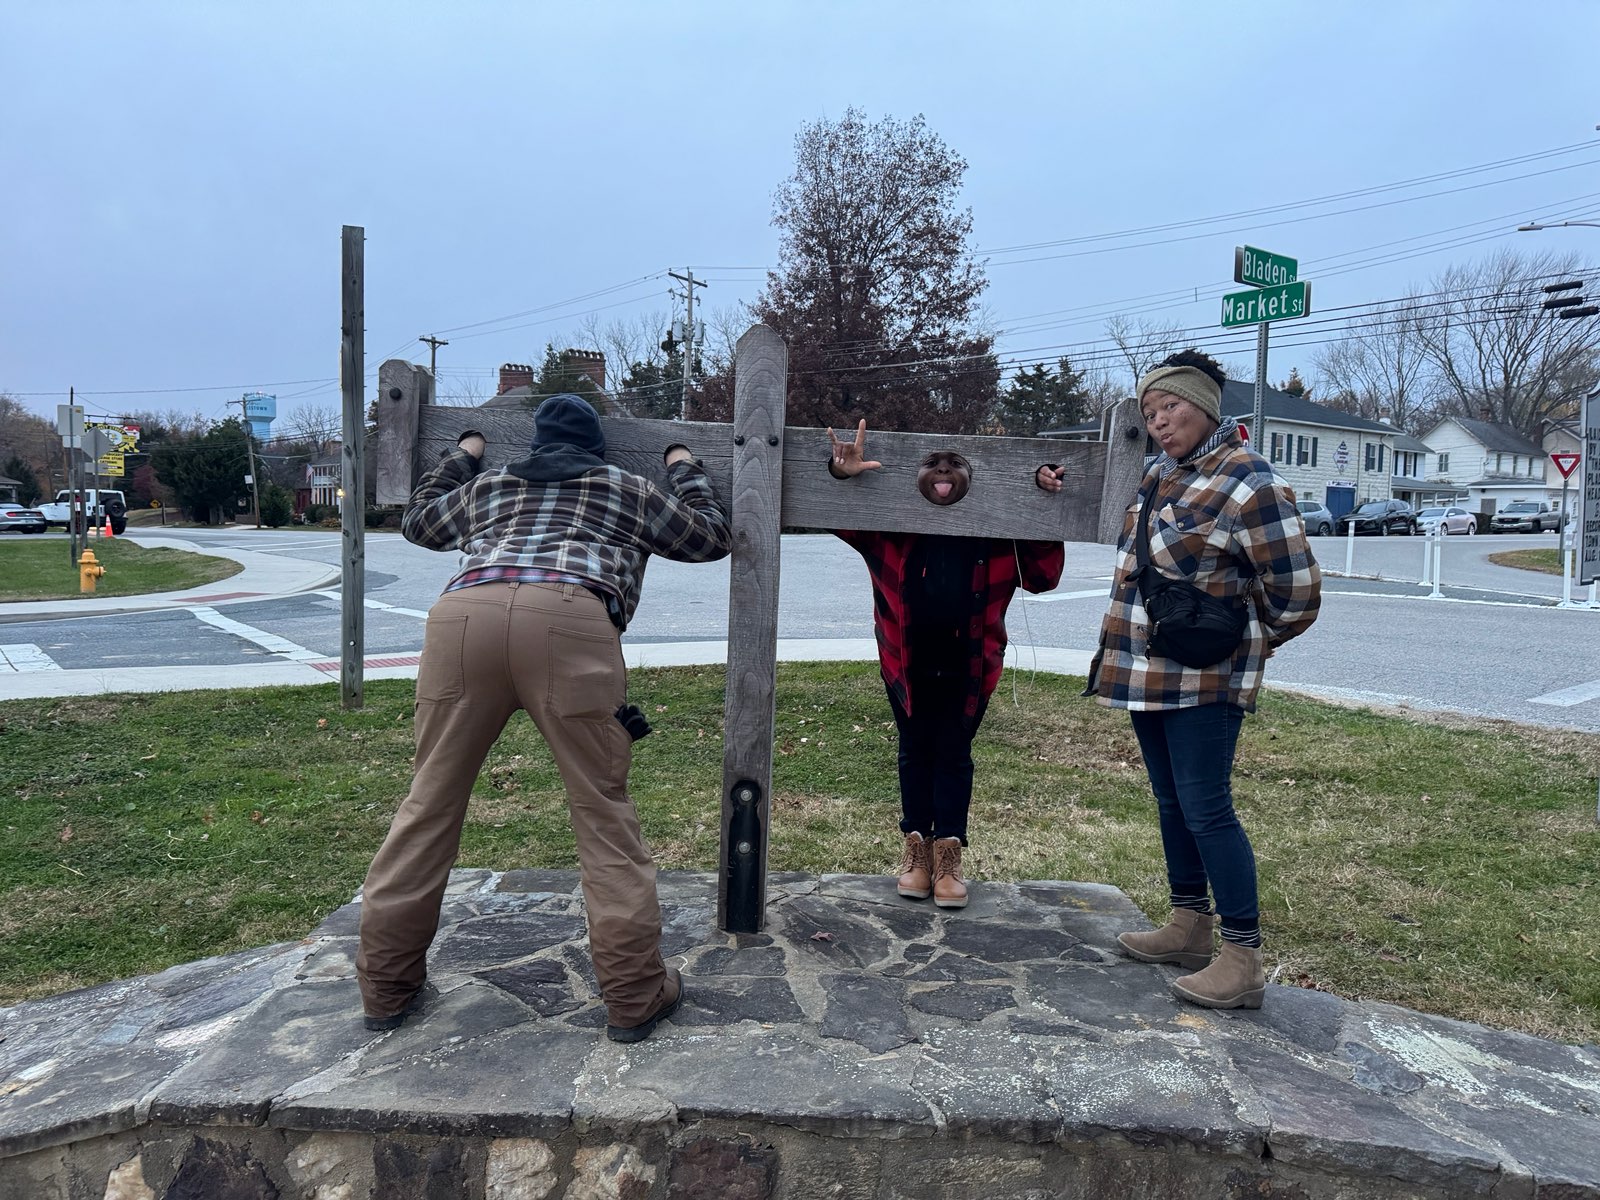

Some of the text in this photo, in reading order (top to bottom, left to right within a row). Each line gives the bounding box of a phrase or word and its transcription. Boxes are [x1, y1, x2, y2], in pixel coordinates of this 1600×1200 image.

[1244, 250, 1287, 285] Bladen
[1222, 289, 1303, 323] Market St
